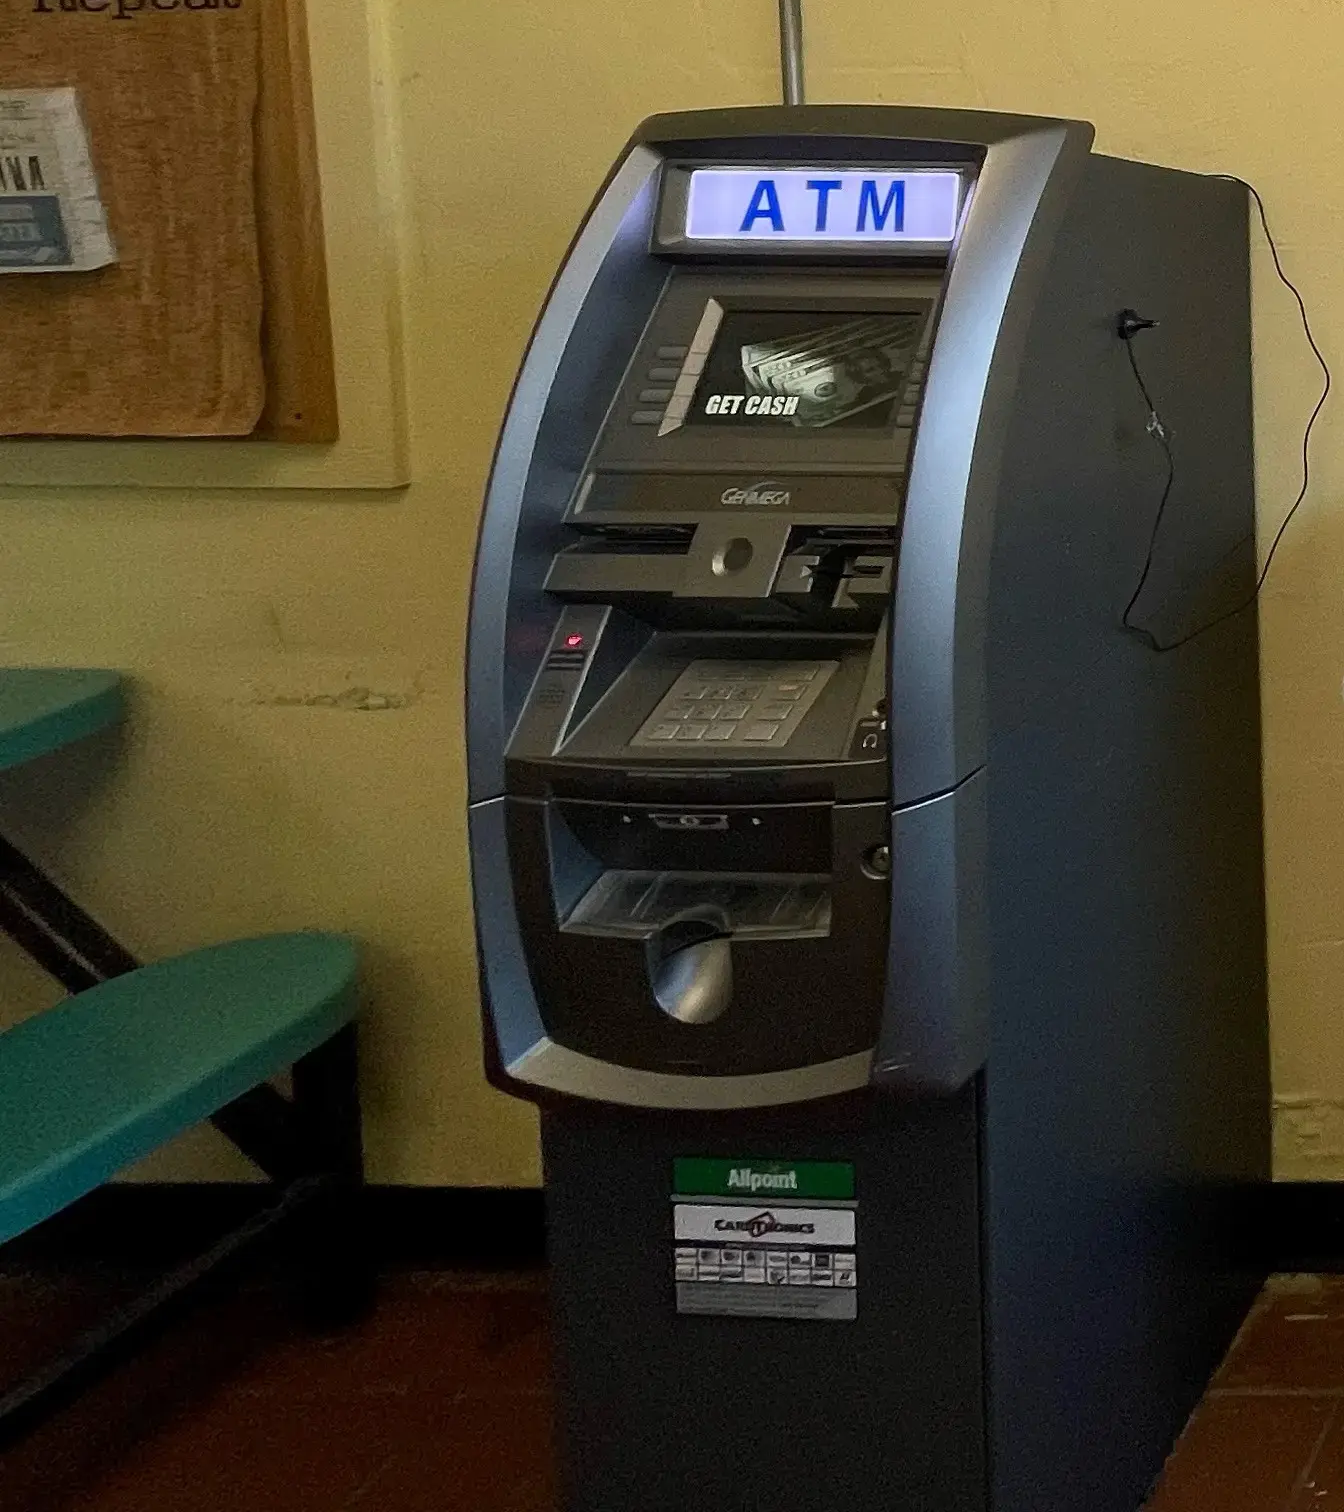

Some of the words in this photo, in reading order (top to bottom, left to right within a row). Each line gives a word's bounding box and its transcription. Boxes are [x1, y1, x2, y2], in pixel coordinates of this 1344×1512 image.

[739, 179, 906, 232] ATM
[704, 394, 745, 415] GET
[744, 394, 800, 416] CASH
[727, 1168, 798, 1191] Allpoint
